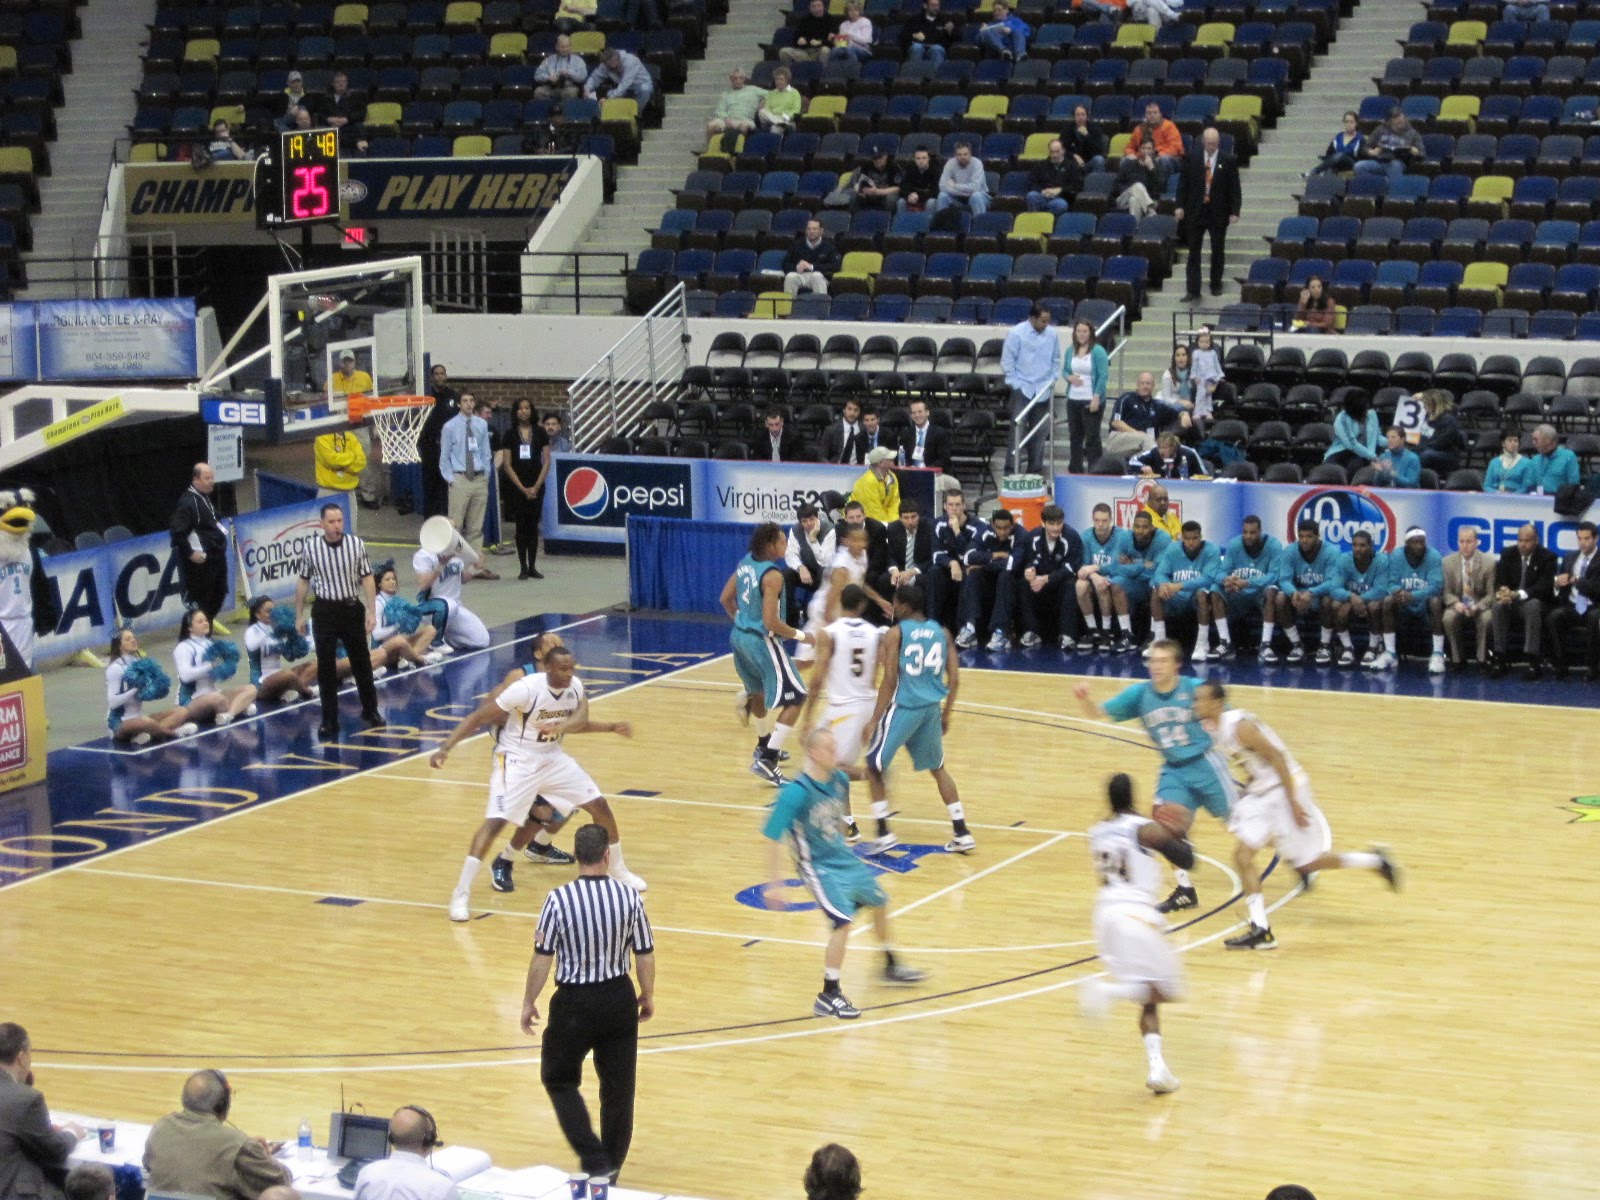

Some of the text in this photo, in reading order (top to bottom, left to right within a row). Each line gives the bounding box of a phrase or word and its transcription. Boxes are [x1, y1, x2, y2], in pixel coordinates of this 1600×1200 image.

[131, 179, 257, 215] CHAMPI
[293, 166, 329, 217] 25
[376, 173, 568, 211] PLAY HERE
[91, 314, 130, 327] MOBILE
[133, 313, 163, 326] X-RAY
[1400, 401, 1421, 429] 3
[613, 483, 684, 511] pepsi
[1447, 517, 1600, 558] GEIC
[14, 576, 21, 595] 1
[115, 553, 188, 619] CA
[260, 559, 300, 582] NETW
[852, 648, 864, 677] 5
[904, 641, 944, 677] 34
